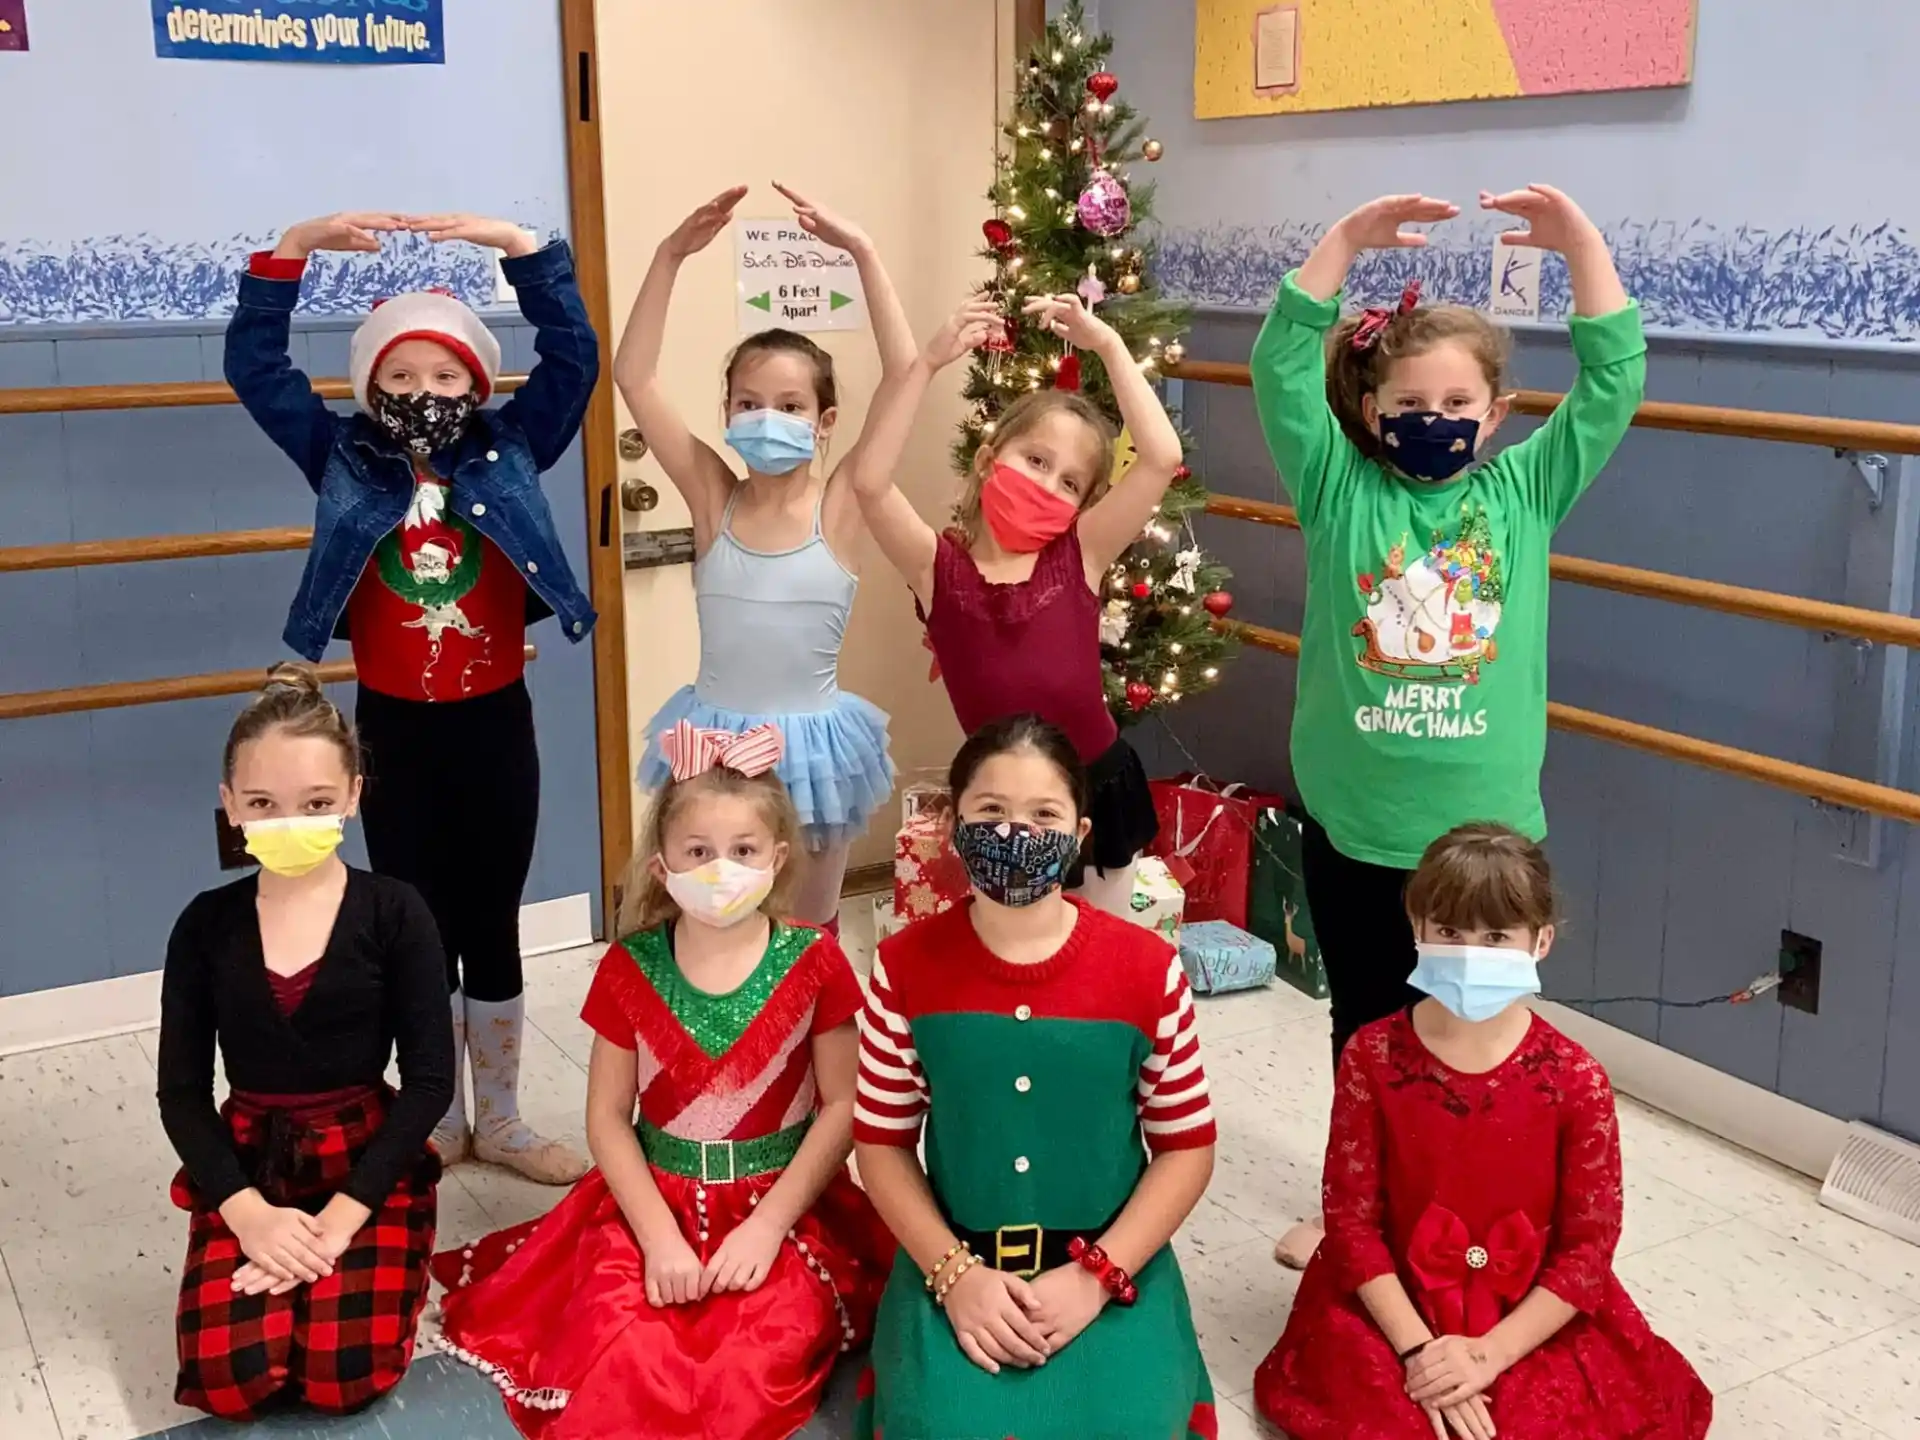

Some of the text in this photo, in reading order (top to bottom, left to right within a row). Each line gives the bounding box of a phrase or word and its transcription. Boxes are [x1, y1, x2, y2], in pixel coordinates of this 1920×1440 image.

[166, 6, 431, 53] determines your future.
[778, 284, 820, 298] 6 Feet
[781, 305, 818, 320] Apart
[1384, 683, 1467, 712] MERRY
[1354, 705, 1488, 739] GRINCHMAS
